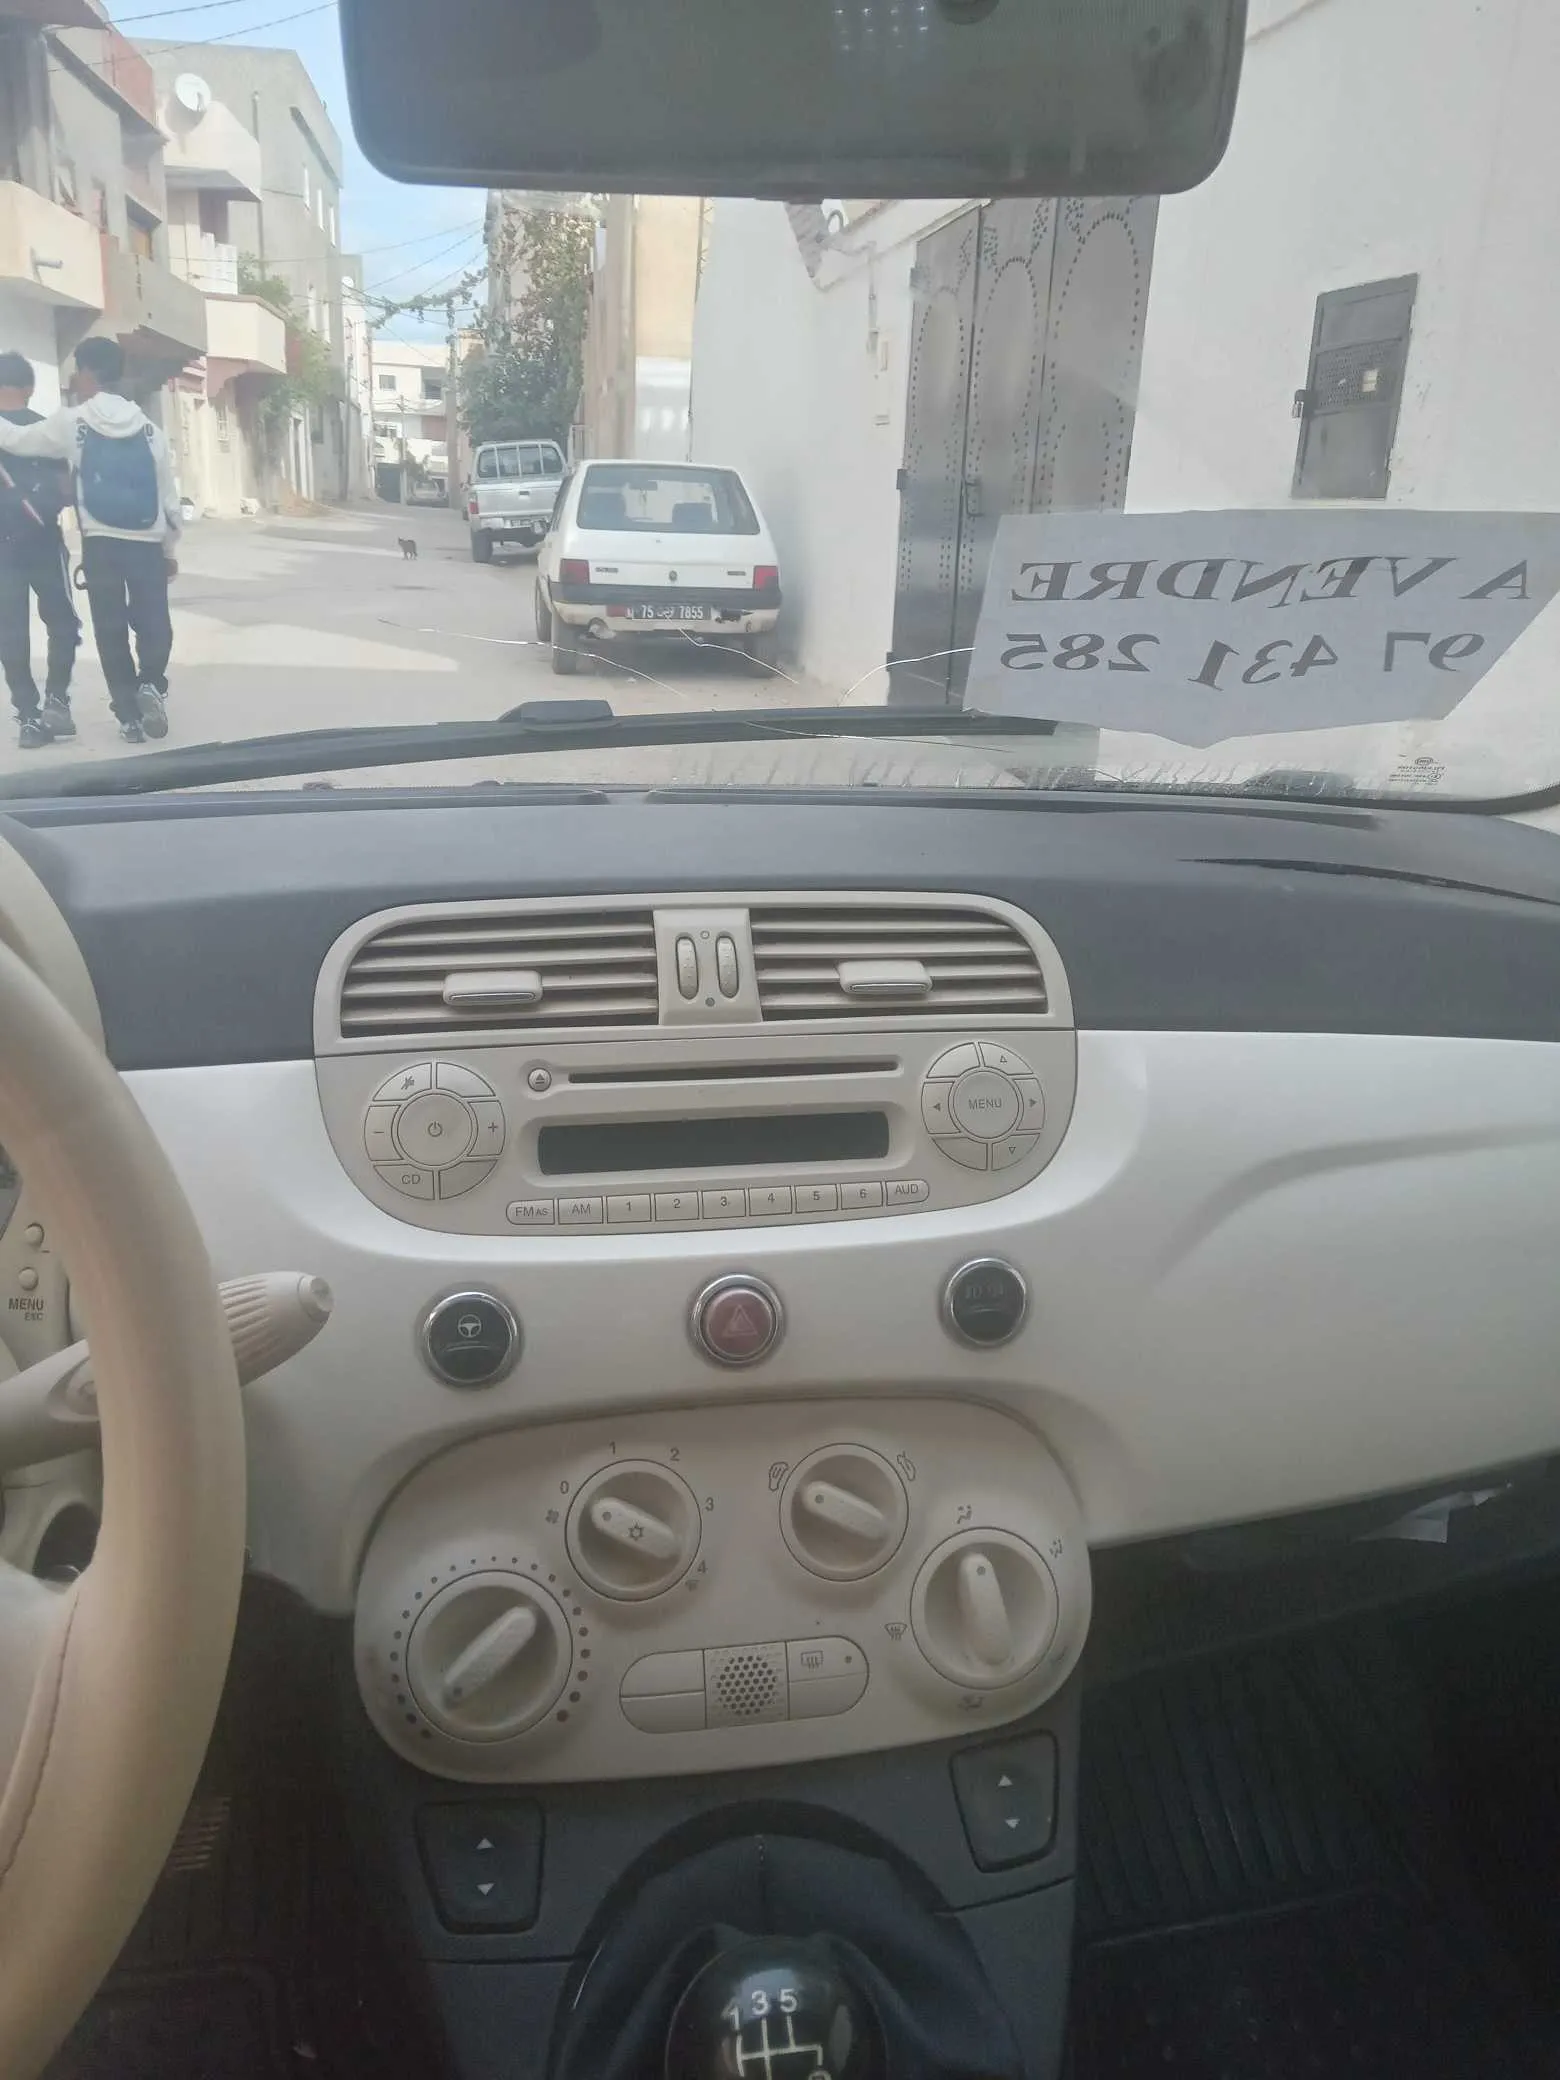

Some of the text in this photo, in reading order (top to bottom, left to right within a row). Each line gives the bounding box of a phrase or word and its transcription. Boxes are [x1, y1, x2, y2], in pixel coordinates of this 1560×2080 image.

[641, 604, 655, 619] 75
[679, 604, 704, 620] 7855
[967, 1097, 1003, 1111] MENU
[401, 1173, 421, 1186] CD
[813, 1190, 821, 1201] 5
[859, 1188, 868, 1199] 6
[895, 1183, 920, 1195] AUD
[673, 1198, 682, 1209] 2
[720, 1196, 728, 1207] 3
[767, 1192, 775, 1203] 4
[515, 1206, 534, 1218] FM
[571, 1203, 592, 1216] AM
[625, 1201, 632, 1212] 1
[8, 1298, 45, 1311] MENU
[609, 1441, 616, 1454] 1
[670, 1447, 680, 1461] 2
[559, 1480, 570, 1495] 0
[705, 1497, 715, 1512] 3
[697, 1559, 708, 1574] 4
[727, 1988, 798, 2031] 1 3 5
